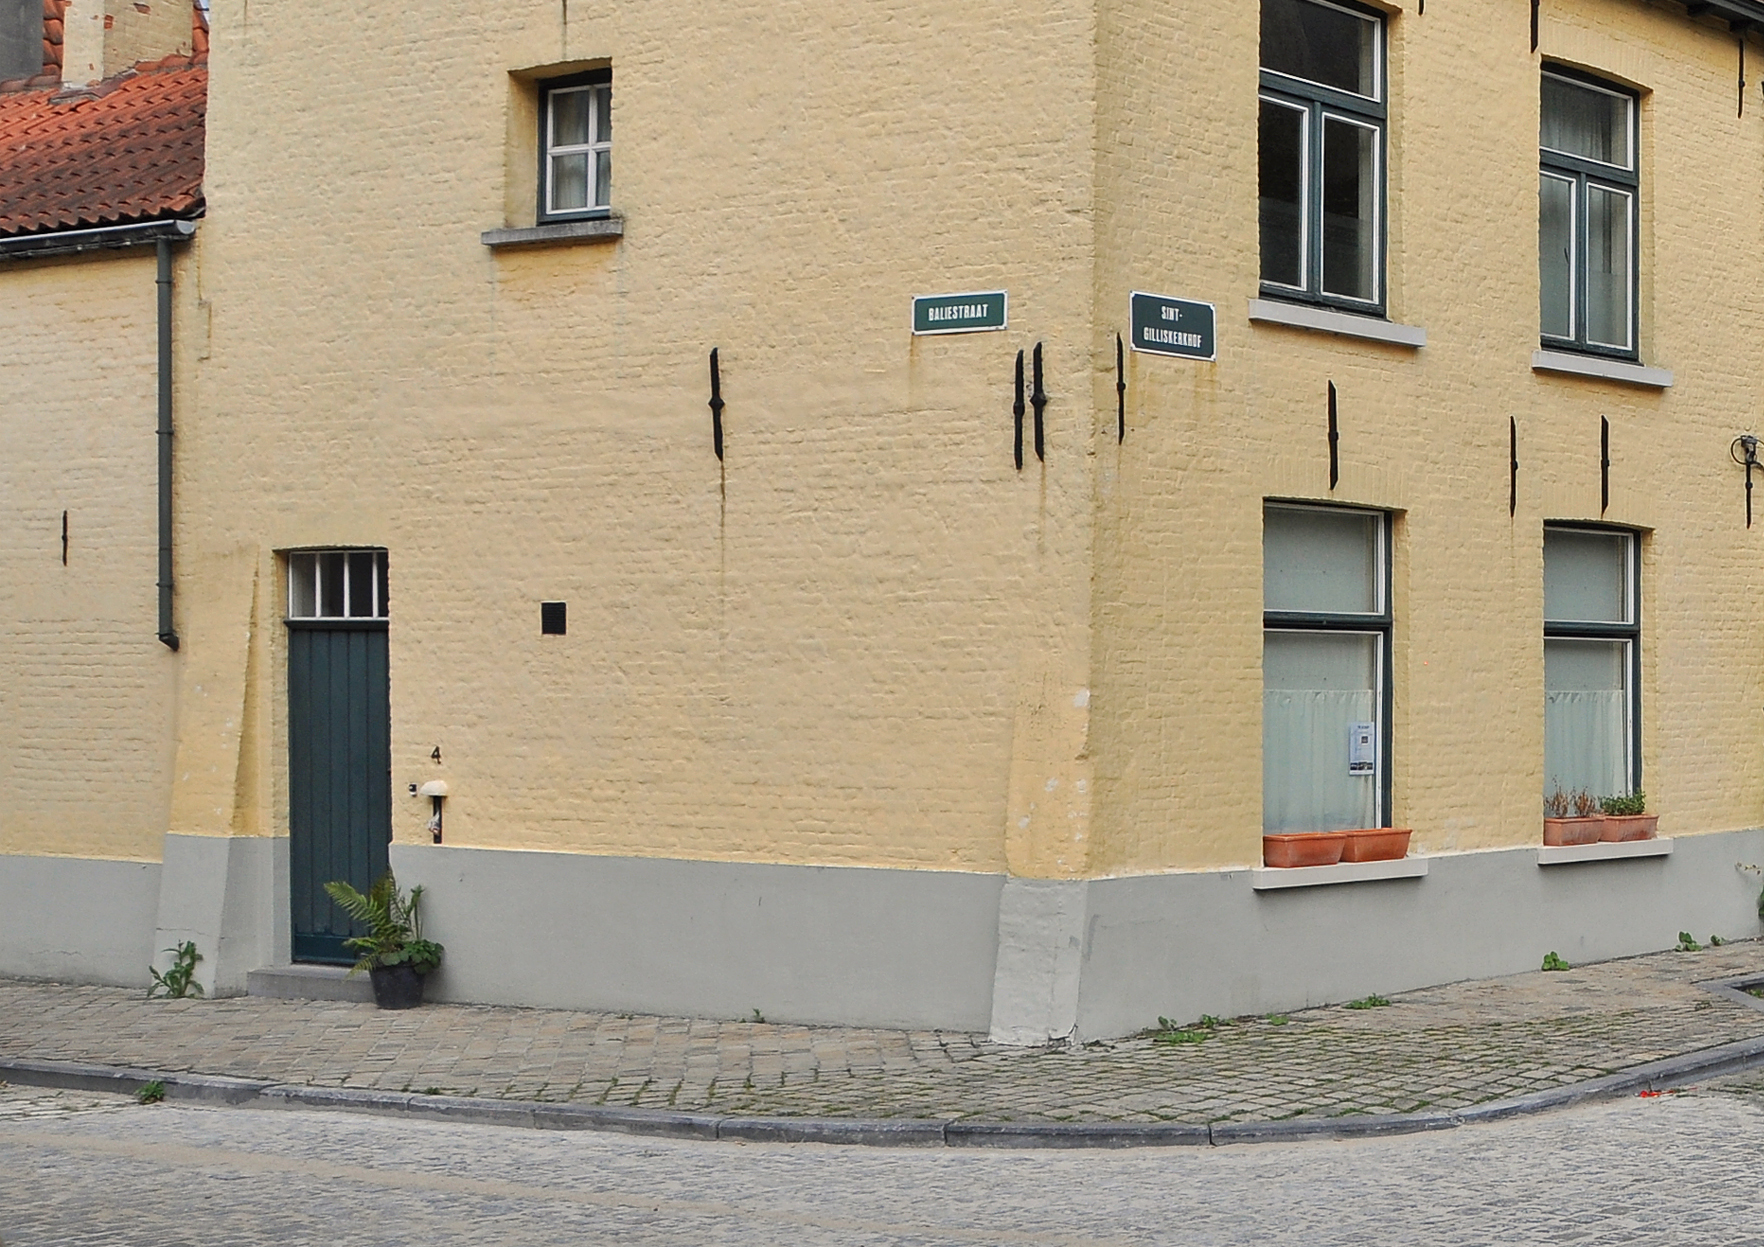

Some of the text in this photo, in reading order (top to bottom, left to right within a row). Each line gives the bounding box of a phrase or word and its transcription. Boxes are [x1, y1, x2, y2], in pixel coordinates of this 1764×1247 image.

[928, 304, 988, 322] BALIESTRAAT
[1143, 326, 1202, 349] GILLISKERKHOF
[430, 745, 441, 765] 4
